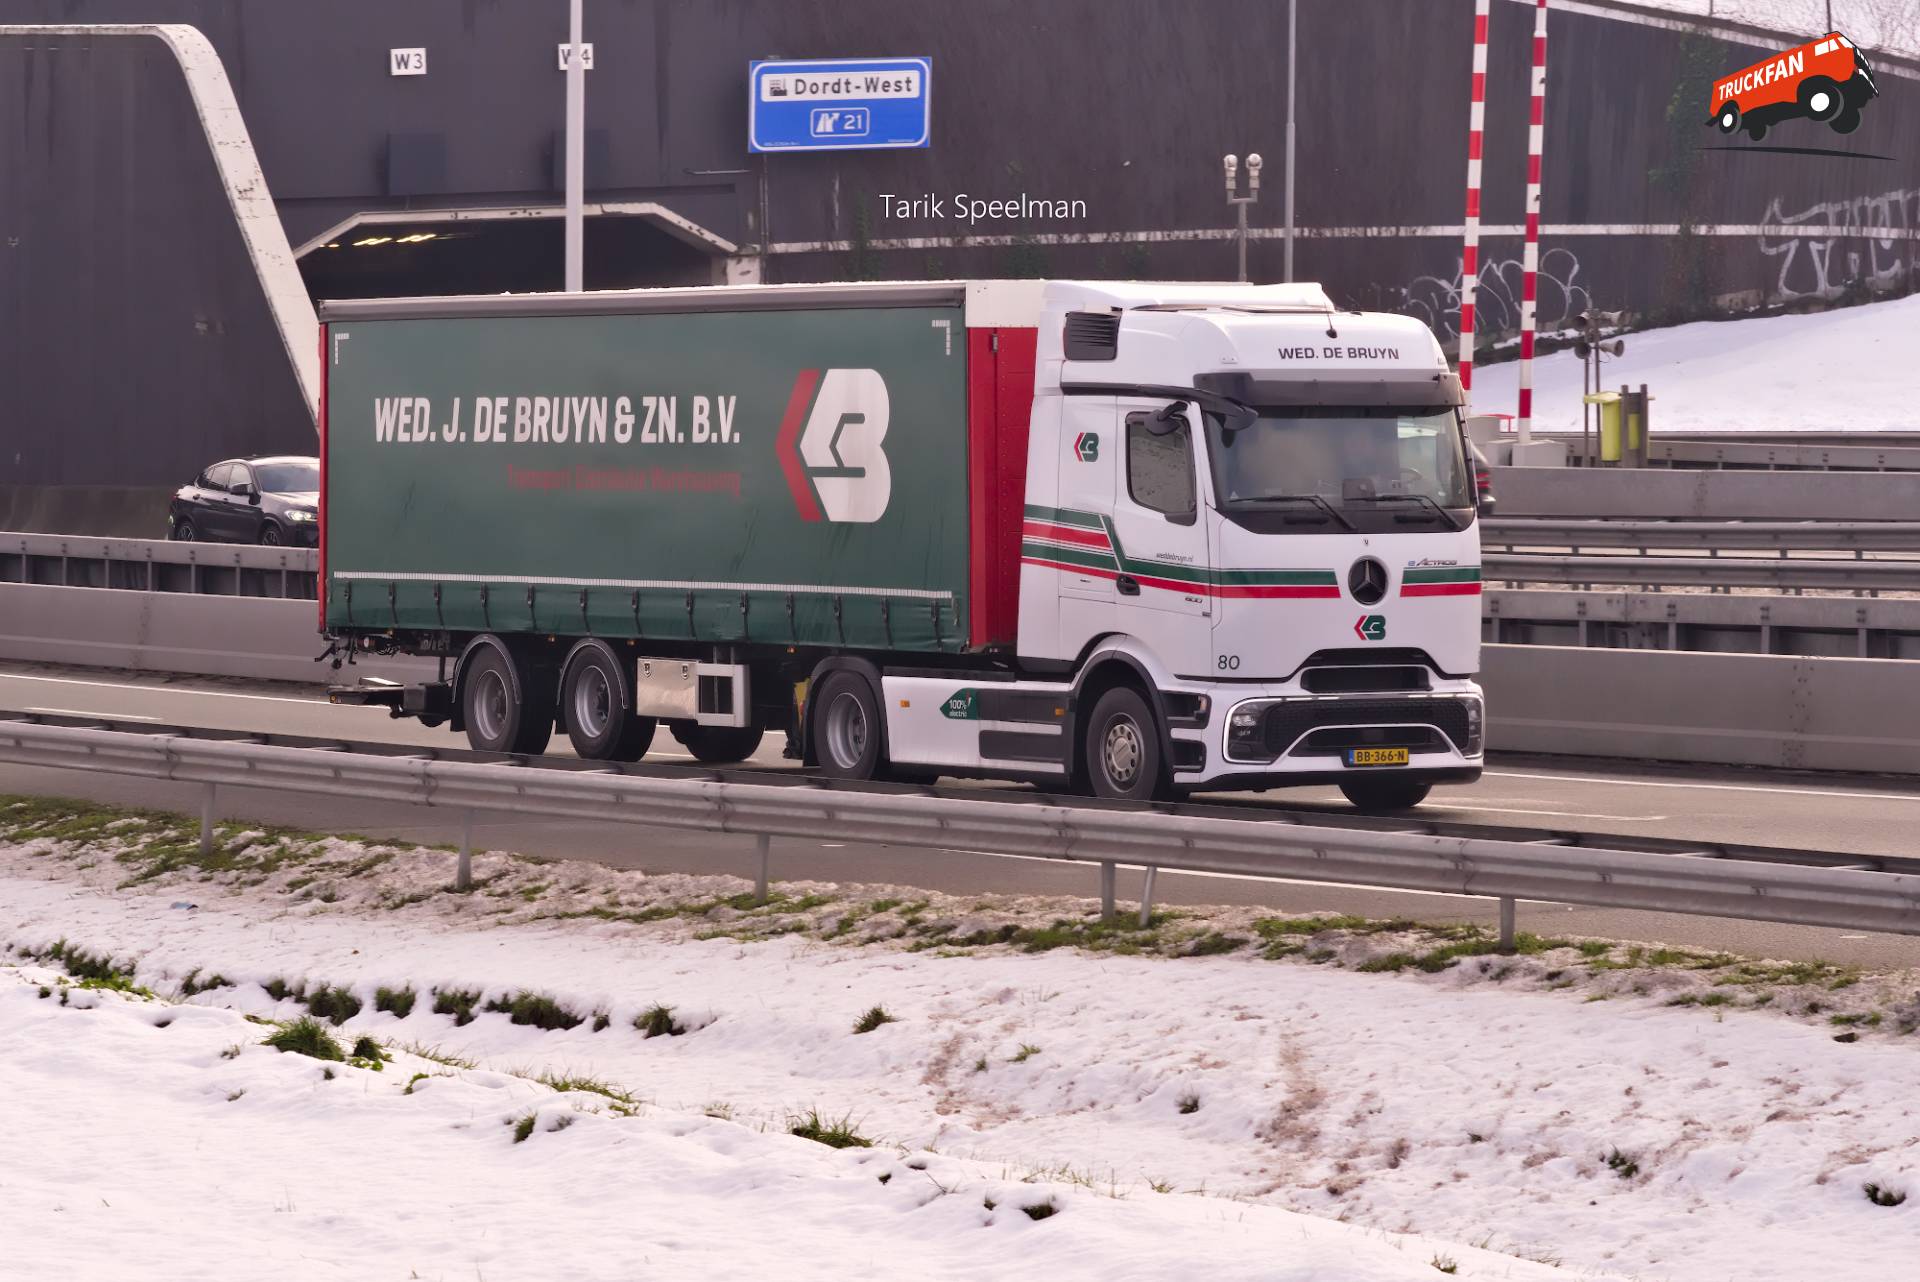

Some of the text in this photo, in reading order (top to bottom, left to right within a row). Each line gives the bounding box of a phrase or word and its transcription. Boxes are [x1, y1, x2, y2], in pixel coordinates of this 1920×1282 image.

[794, 76, 913, 96] Dordt-West
[843, 114, 863, 130] 21
[1278, 346, 1400, 360] WED. DE BRUYN
[375, 395, 741, 444] WED. J. DE BRUYN & ZN. B.V.
[1218, 655, 1240, 670] 80
[1356, 751, 1405, 762] BB-366-N
